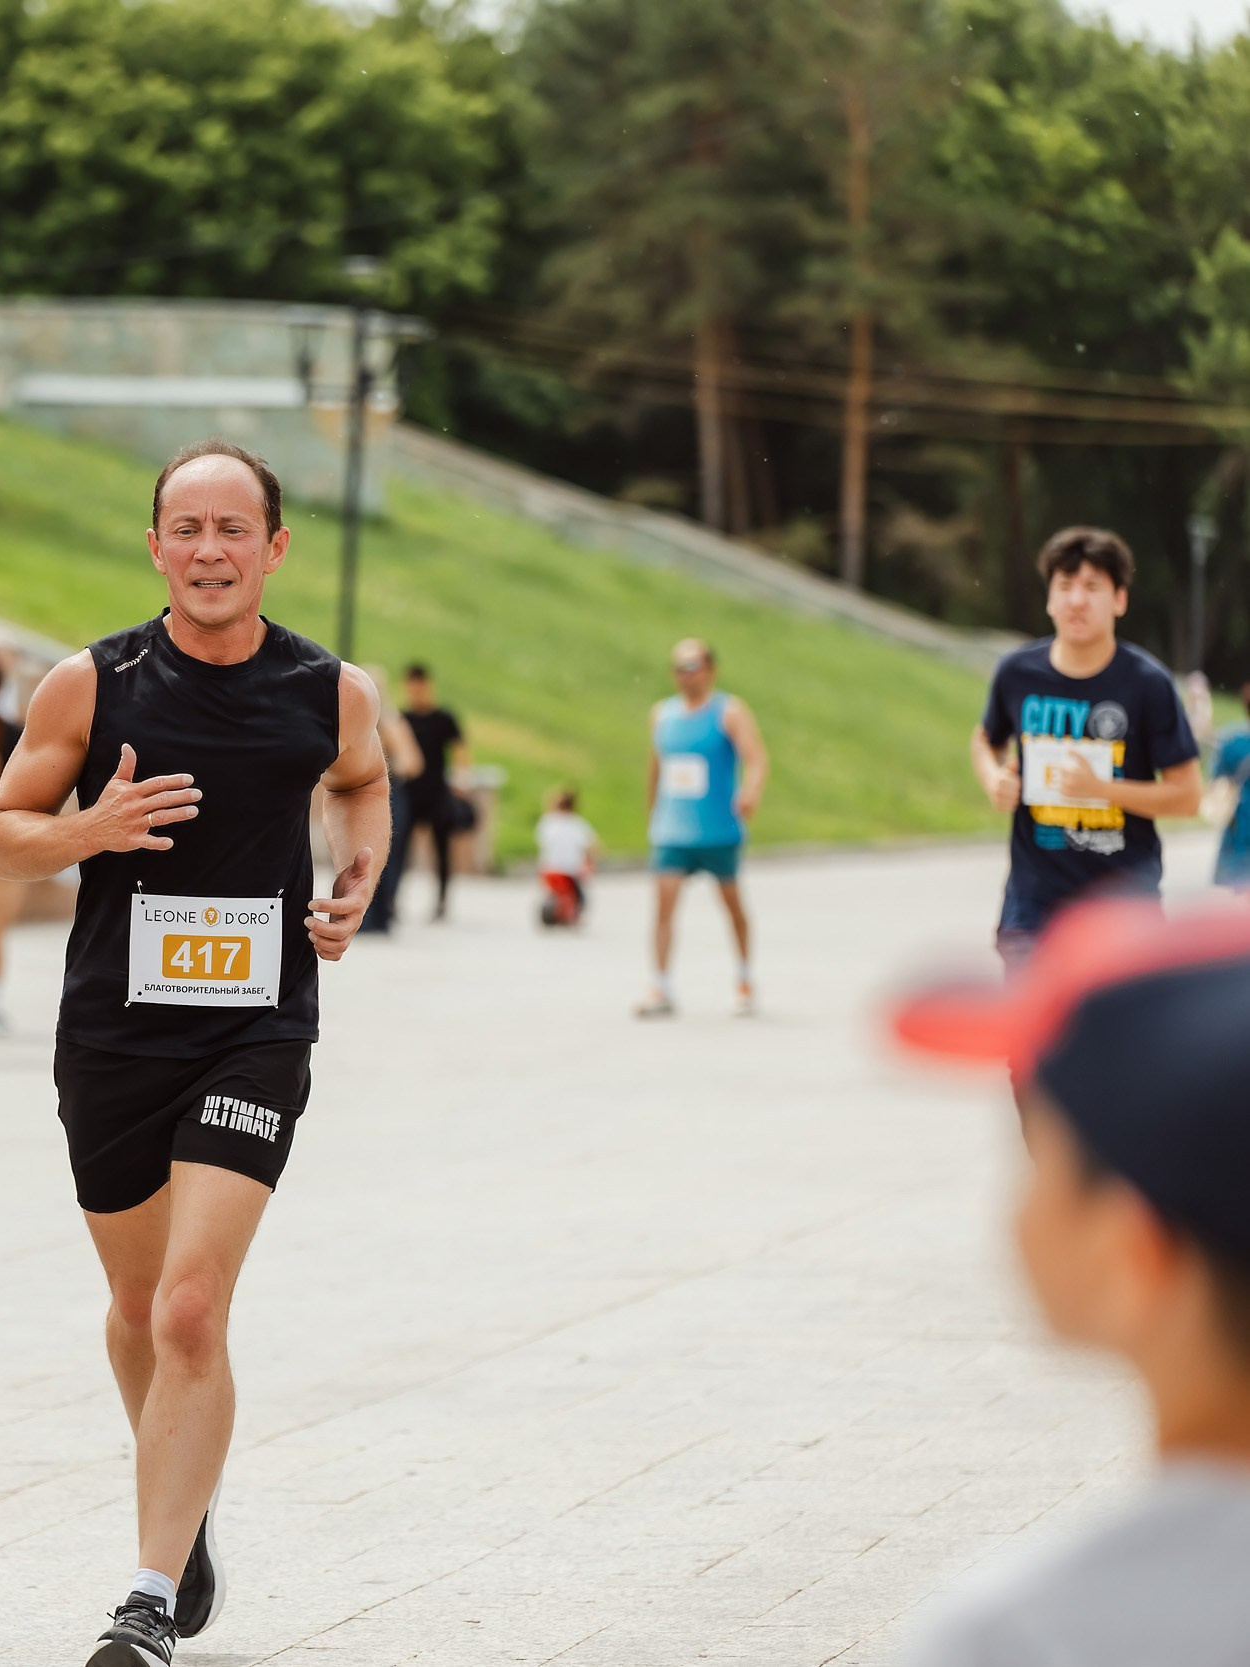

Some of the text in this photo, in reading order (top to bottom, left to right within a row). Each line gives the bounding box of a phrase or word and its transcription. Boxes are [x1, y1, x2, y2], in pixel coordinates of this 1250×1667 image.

[1022, 695, 1090, 739] CITY
[145, 910, 270, 925] LEONE D'ORO
[170, 940, 242, 974] 417
[144, 984, 265, 995] БЛАГОТВОРИТЕЛЬНЫЙ ЗАБЕГ
[200, 1095, 281, 1142] ULTIMATE
